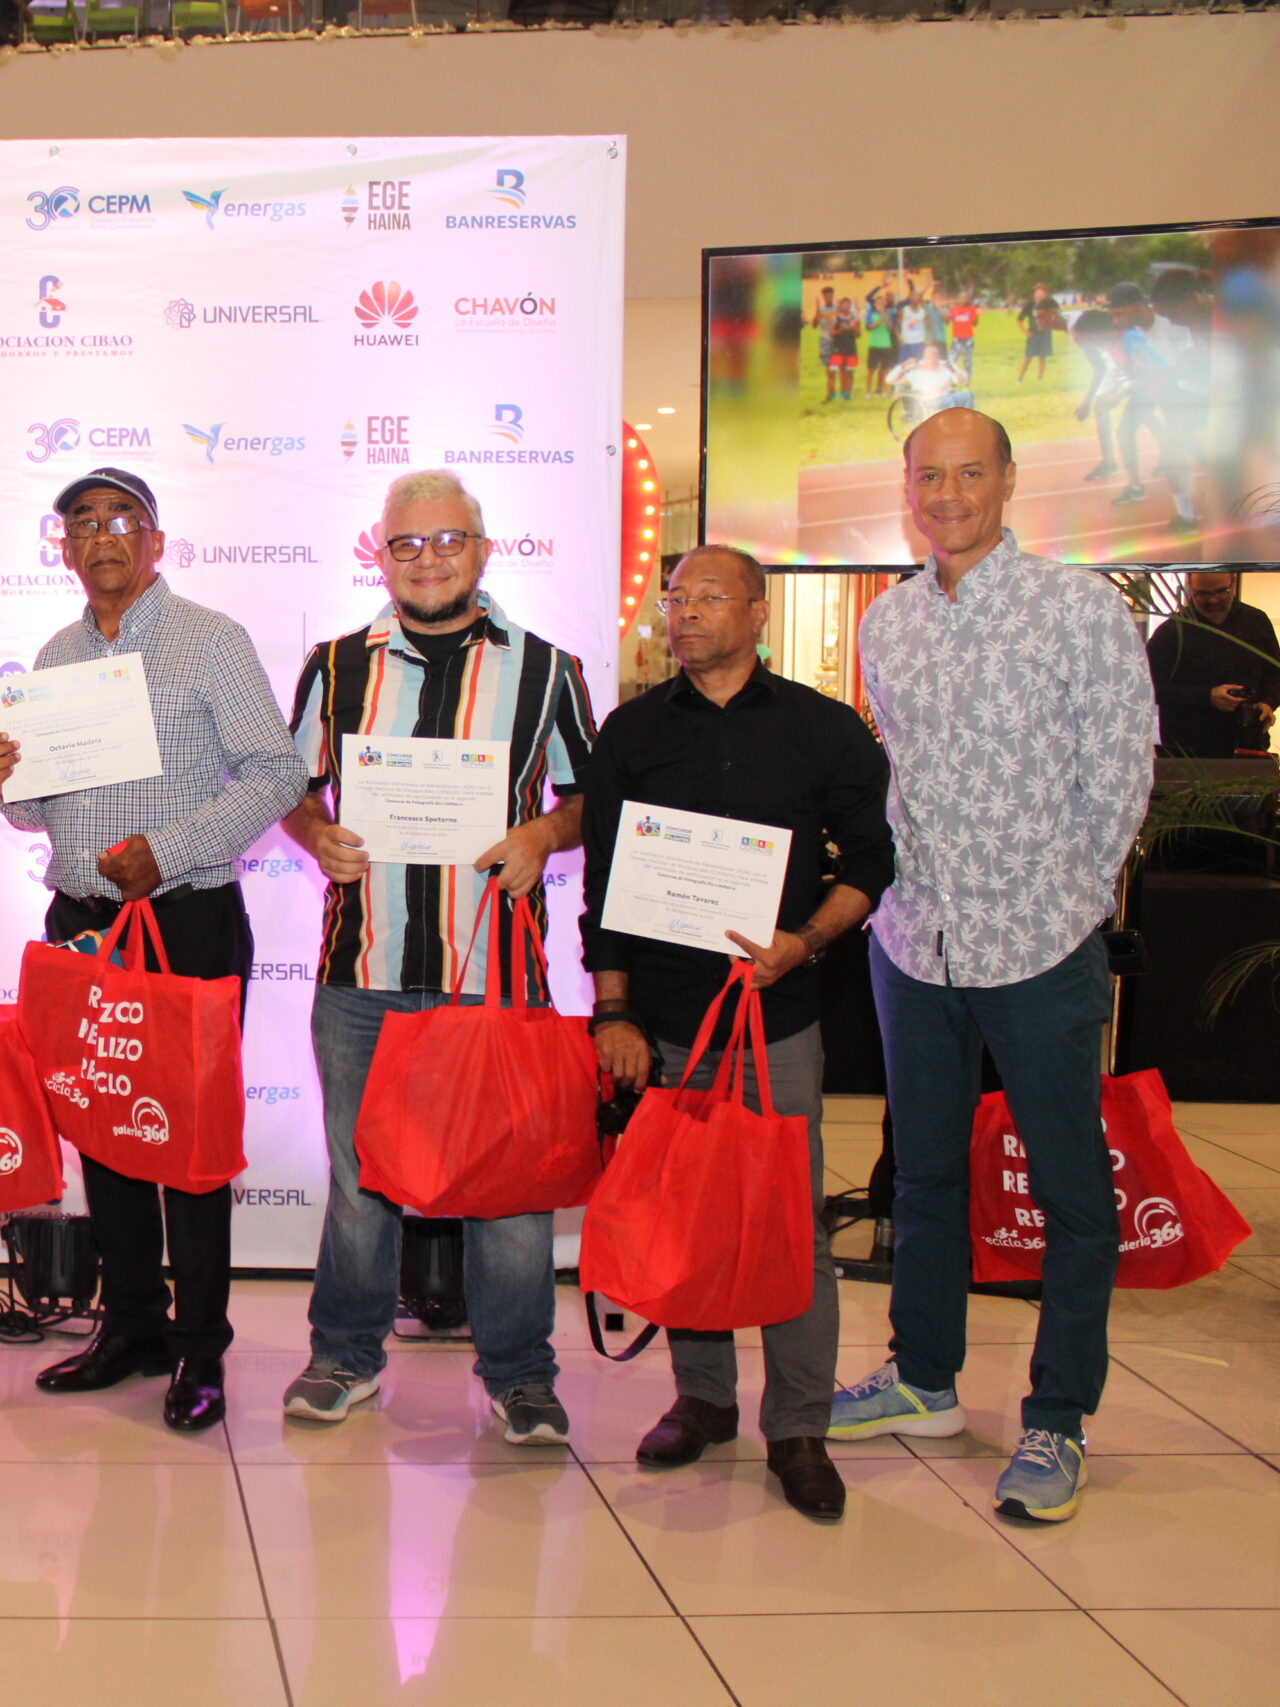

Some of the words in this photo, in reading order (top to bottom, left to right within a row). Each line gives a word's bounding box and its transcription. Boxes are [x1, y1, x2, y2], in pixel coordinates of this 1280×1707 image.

[88, 195, 151, 214] CEPM
[368, 181, 411, 210] EGE
[224, 202, 307, 221] energas
[368, 213, 411, 230] HAINA
[445, 215, 577, 229] BANRESERVAS
[454, 292, 556, 315] CHAVÓN
[203, 305, 319, 323] UNIVERSAL
[81, 335, 133, 347] CIBAO
[354, 335, 419, 346] HUAWEI
[89, 427, 151, 447] CEPM
[367, 416, 410, 445] EGE
[223, 436, 306, 456] energas
[367, 447, 410, 464] HAINA
[444, 450, 574, 464] BANRESERVAS
[490, 533, 553, 557] AVÓN
[203, 546, 319, 563] UNIVERSAL
[49, 742, 75, 752] Octavio
[77, 737, 102, 748] Madera
[389, 814, 423, 823] Francesco
[425, 816, 458, 825] Spotorno
[241, 859, 303, 878] ergas
[666, 890, 691, 901] Ramón
[692, 895, 719, 906] Tavarez
[250, 963, 315, 981] ERSAL
[246, 1086, 300, 1104] ergas
[234, 1189, 312, 1206] VERSAL
[1118, 1221, 1184, 1253] aleria360
